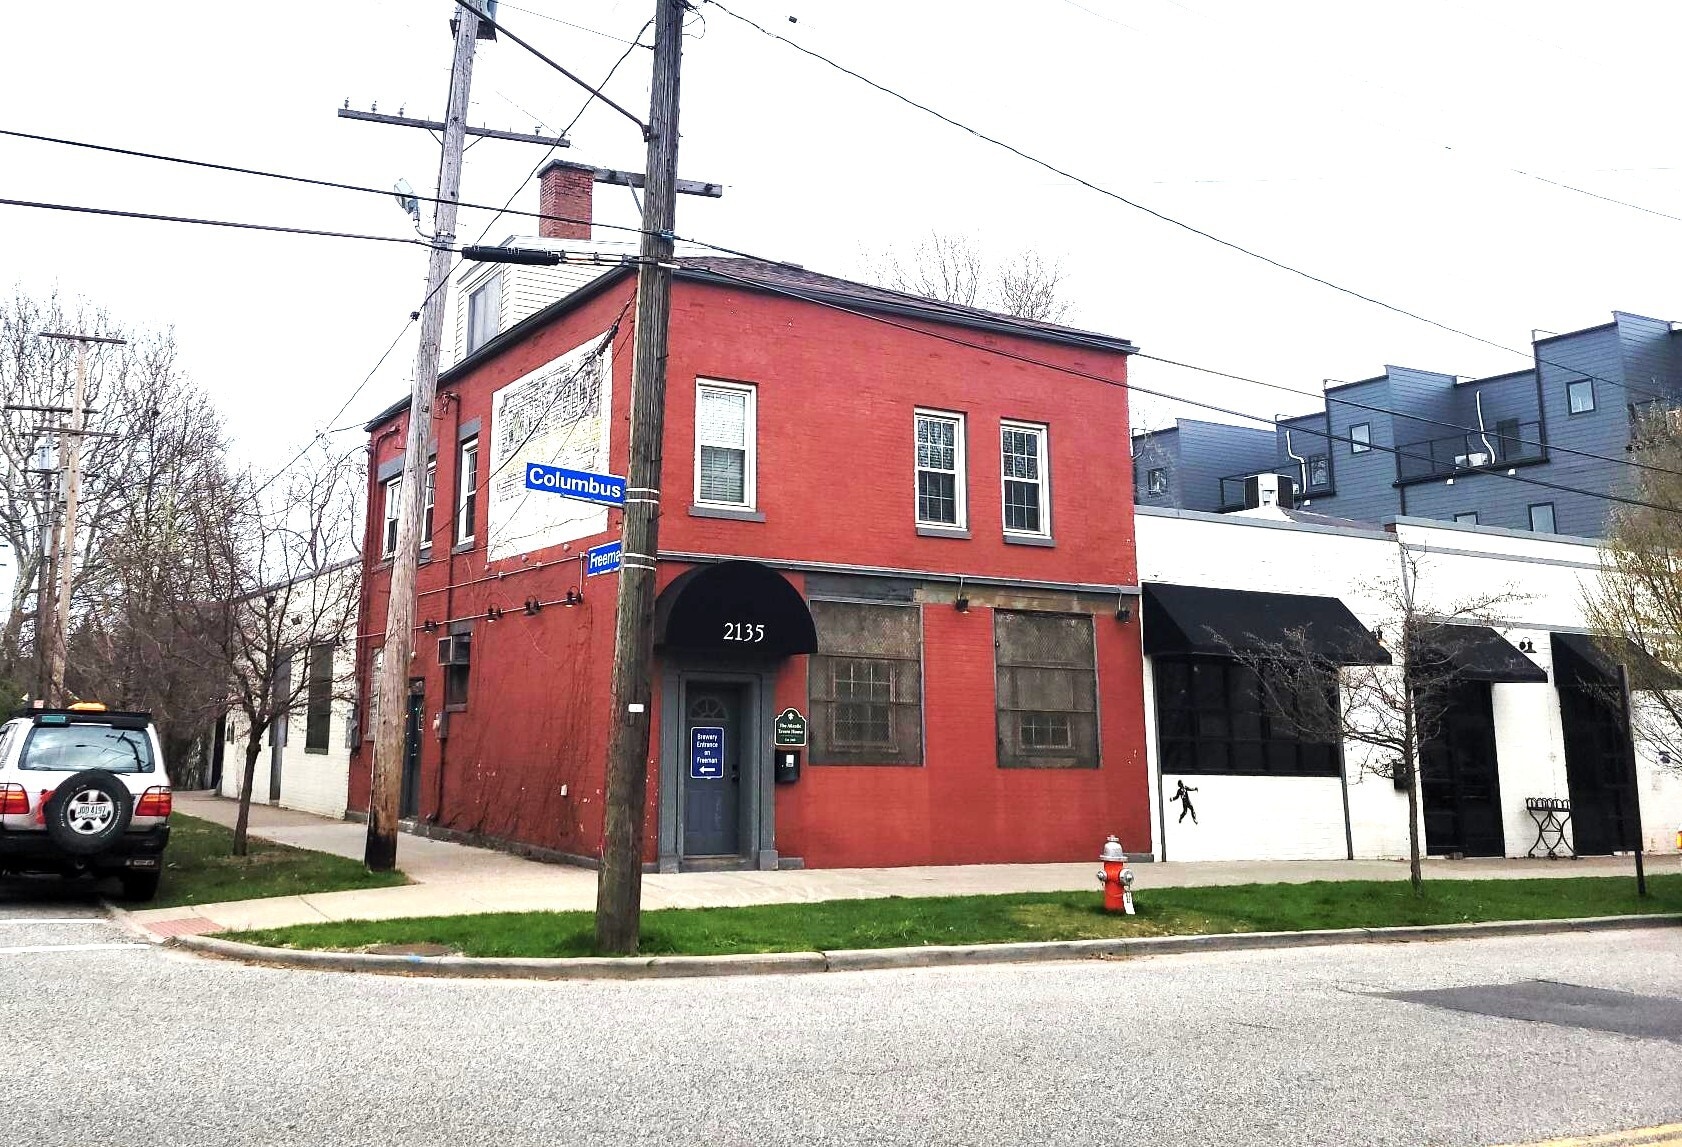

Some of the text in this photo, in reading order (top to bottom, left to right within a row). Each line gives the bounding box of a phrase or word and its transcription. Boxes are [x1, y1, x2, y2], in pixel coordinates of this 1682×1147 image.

[529, 467, 621, 498] Columbus
[590, 550, 621, 569] Freema
[723, 622, 765, 643] 2135
[696, 740, 719, 748] Entrance
[697, 733, 718, 742] Brewery
[696, 756, 718, 764] Freeman
